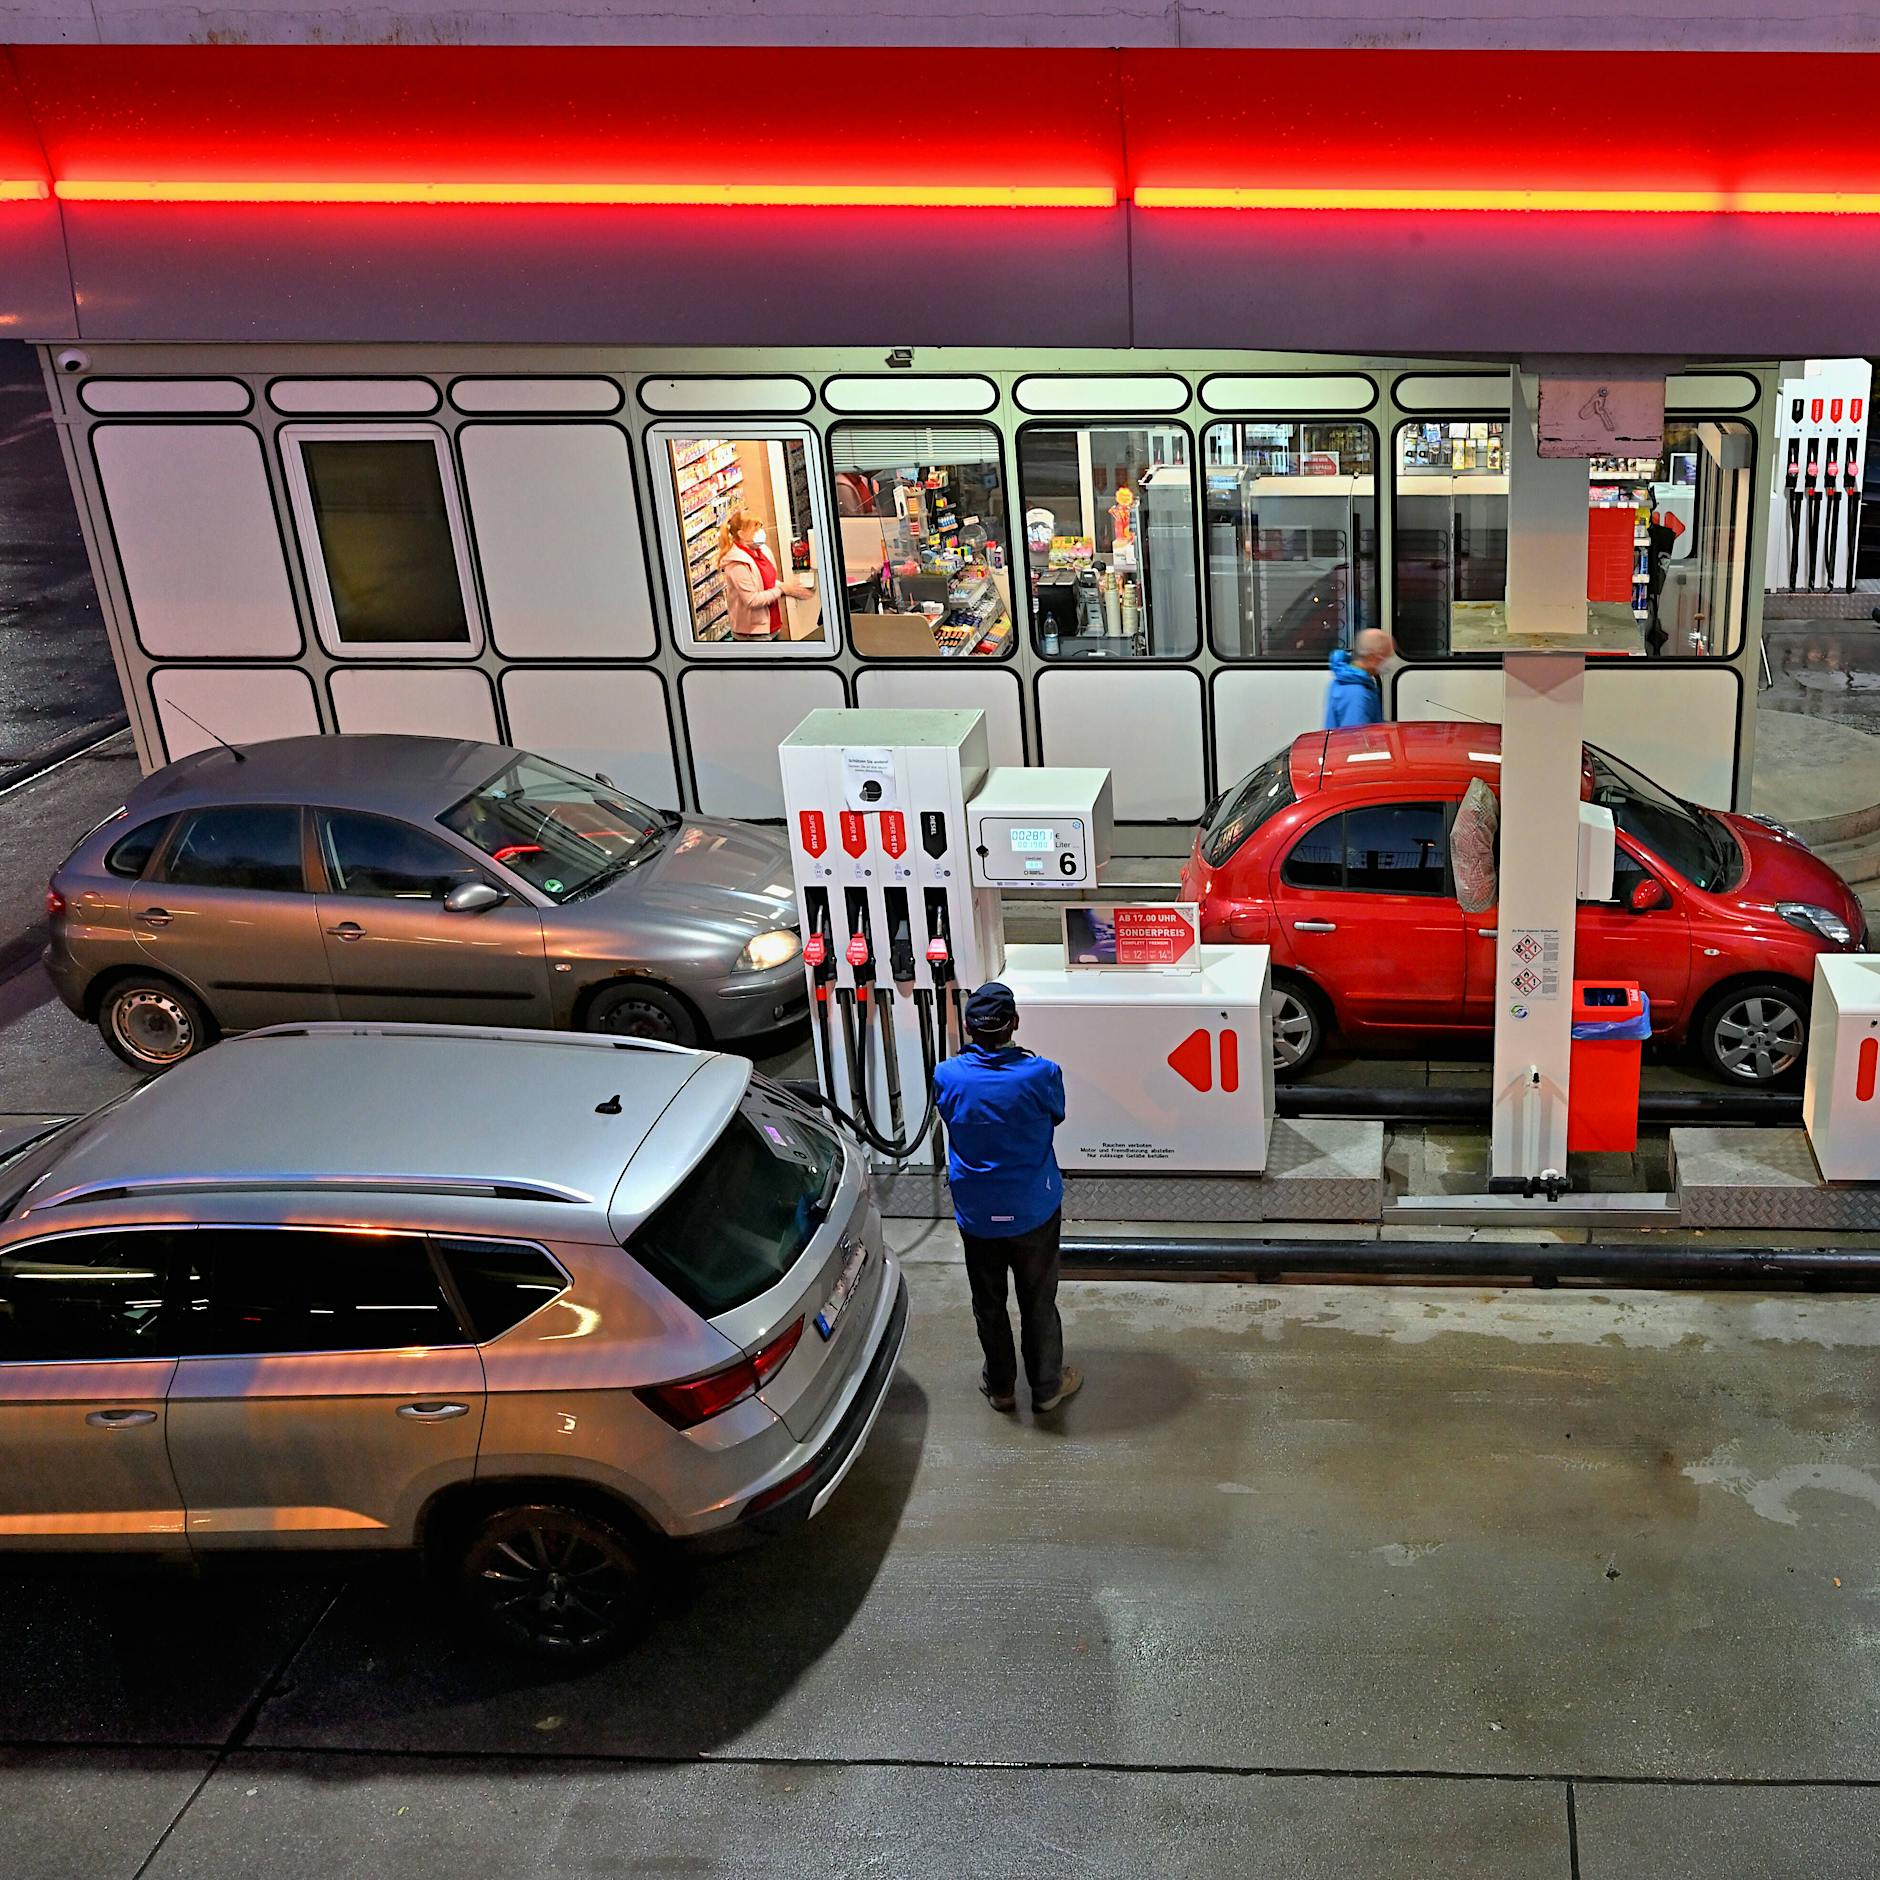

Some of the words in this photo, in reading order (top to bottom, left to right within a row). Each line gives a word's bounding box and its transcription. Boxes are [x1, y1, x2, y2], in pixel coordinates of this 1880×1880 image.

[808, 815, 817, 834] SUPER
[848, 815, 857, 834] SUPER
[888, 815, 896, 834] SUPER
[929, 815, 937, 835] DIESEL
[810, 833, 819, 850] PLUS
[850, 834, 858, 842] 95
[890, 834, 898, 842] 95
[1059, 852, 1077, 876] 6
[1118, 914, 1131, 922] AB
[1133, 914, 1156, 922] 17.00
[1158, 914, 1177, 922] UHR
[1119, 928, 1185, 937] SONDERPREIS
[1133, 950, 1142, 959] 12
[1158, 950, 1168, 959] 14
